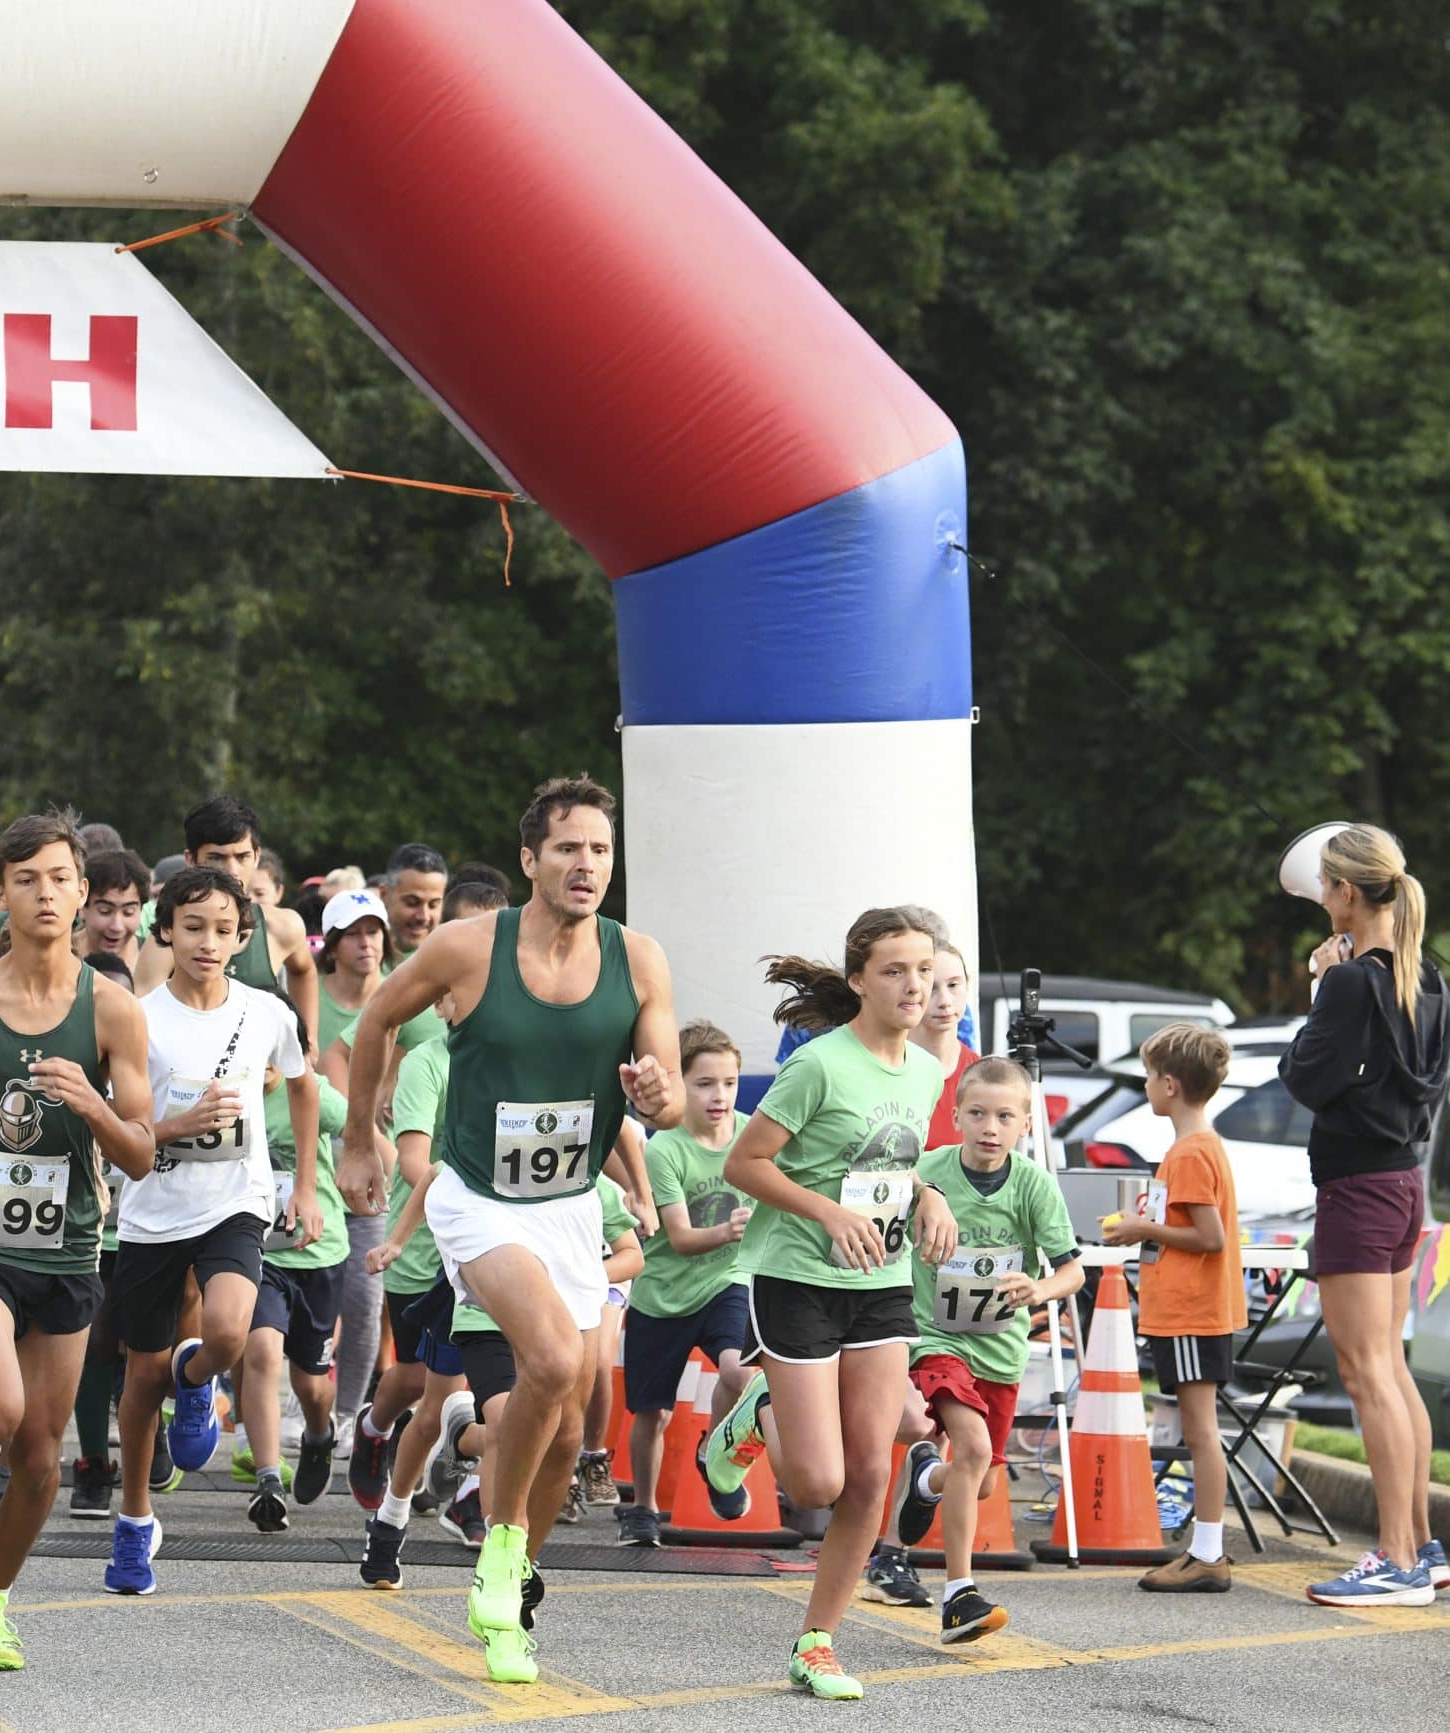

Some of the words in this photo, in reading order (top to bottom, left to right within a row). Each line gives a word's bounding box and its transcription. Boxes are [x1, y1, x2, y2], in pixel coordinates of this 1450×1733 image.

[167, 1115, 243, 1150] 31
[501, 1144, 588, 1185] 197
[941, 1286, 1015, 1322] 172
